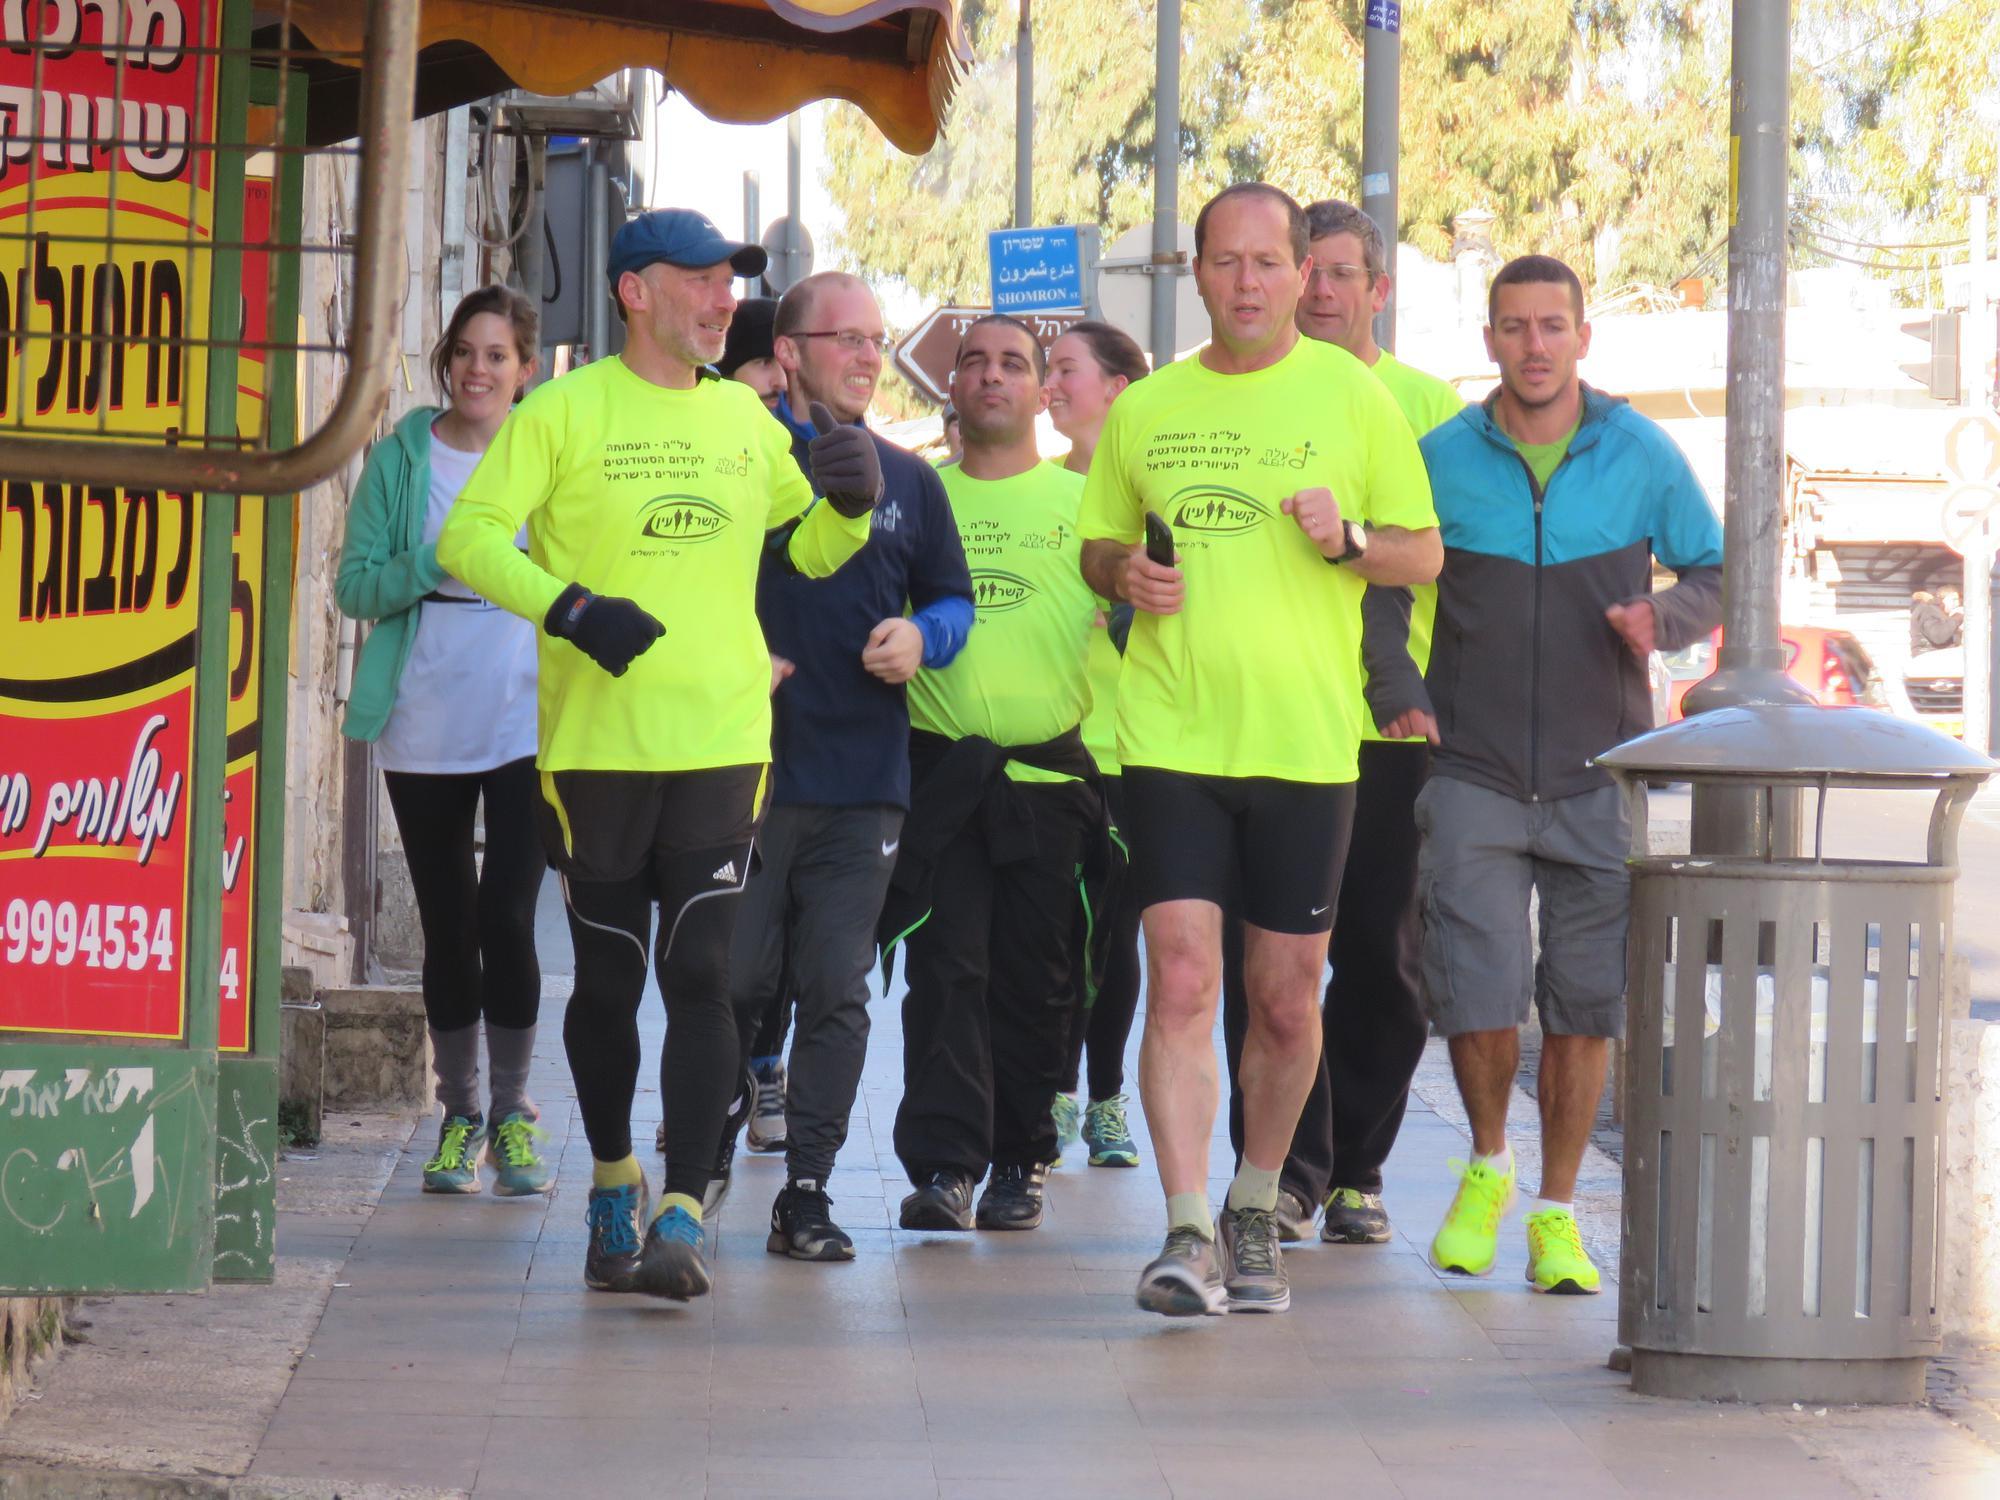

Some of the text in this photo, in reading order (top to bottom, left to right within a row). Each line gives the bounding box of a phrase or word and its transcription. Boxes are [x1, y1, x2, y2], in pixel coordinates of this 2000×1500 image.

[997, 287, 1066, 304] SHOMRON
[0, 231, 183, 416] חיתולי
[1153, 432, 1197, 443] העמותה
[606, 441, 650, 452] העמותה
[1147, 445, 1251, 458] לקידום הסטודנטים
[604, 454, 705, 467] לקידום הסטודנטים
[1146, 460, 1240, 472] העיוורים בישראל
[605, 471, 699, 482] העיוורים בישראל
[1185, 506, 1257, 524] קשר עין
[0, 427, 196, 623] למבוגר
[655, 515, 720, 530] קשר עין
[974, 532, 1011, 543] לקידום
[998, 587, 1024, 599] קשר
